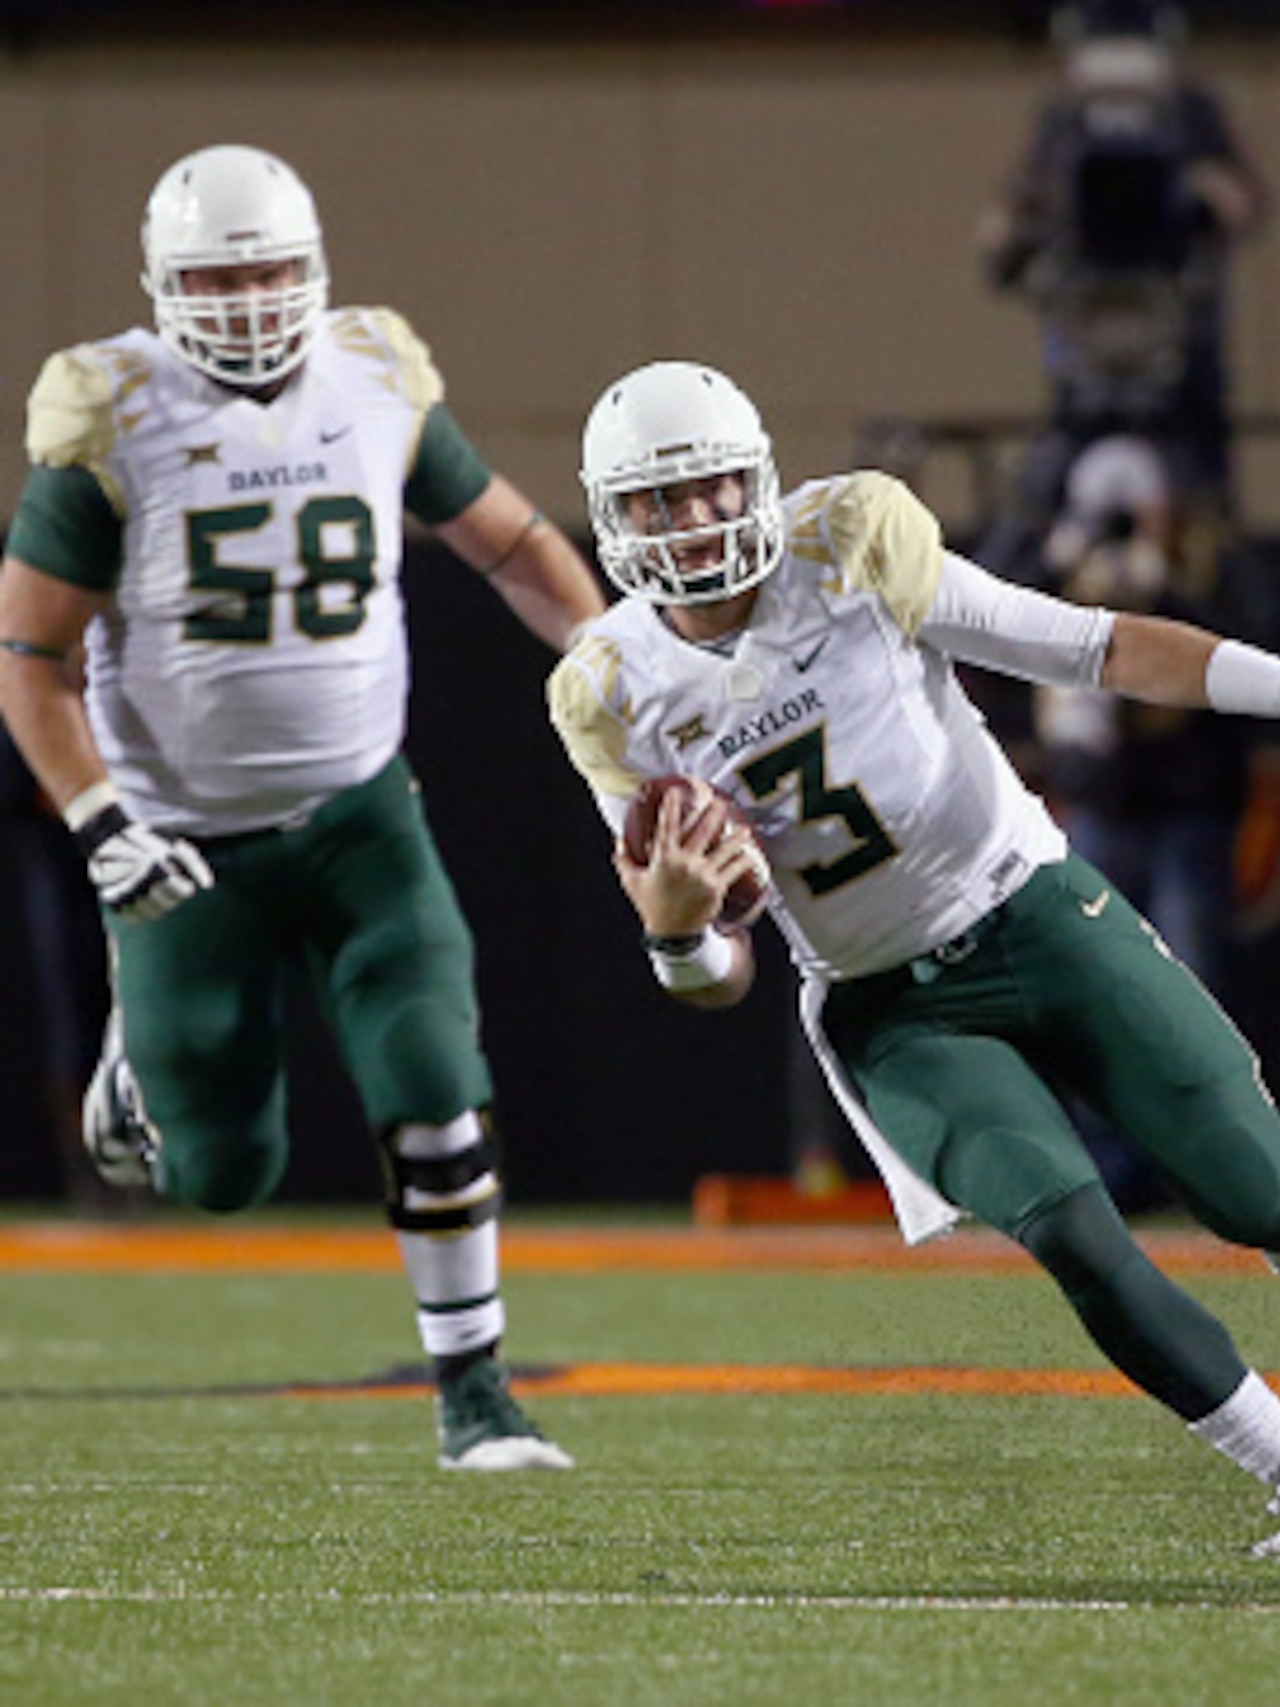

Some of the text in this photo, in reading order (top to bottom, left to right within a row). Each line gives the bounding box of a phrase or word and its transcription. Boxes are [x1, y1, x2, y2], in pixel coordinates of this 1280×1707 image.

[227, 462, 327, 492] BAYLOR
[181, 494, 378, 645] 58
[717, 687, 826, 759] BAYLOR
[734, 719, 904, 897] 3
